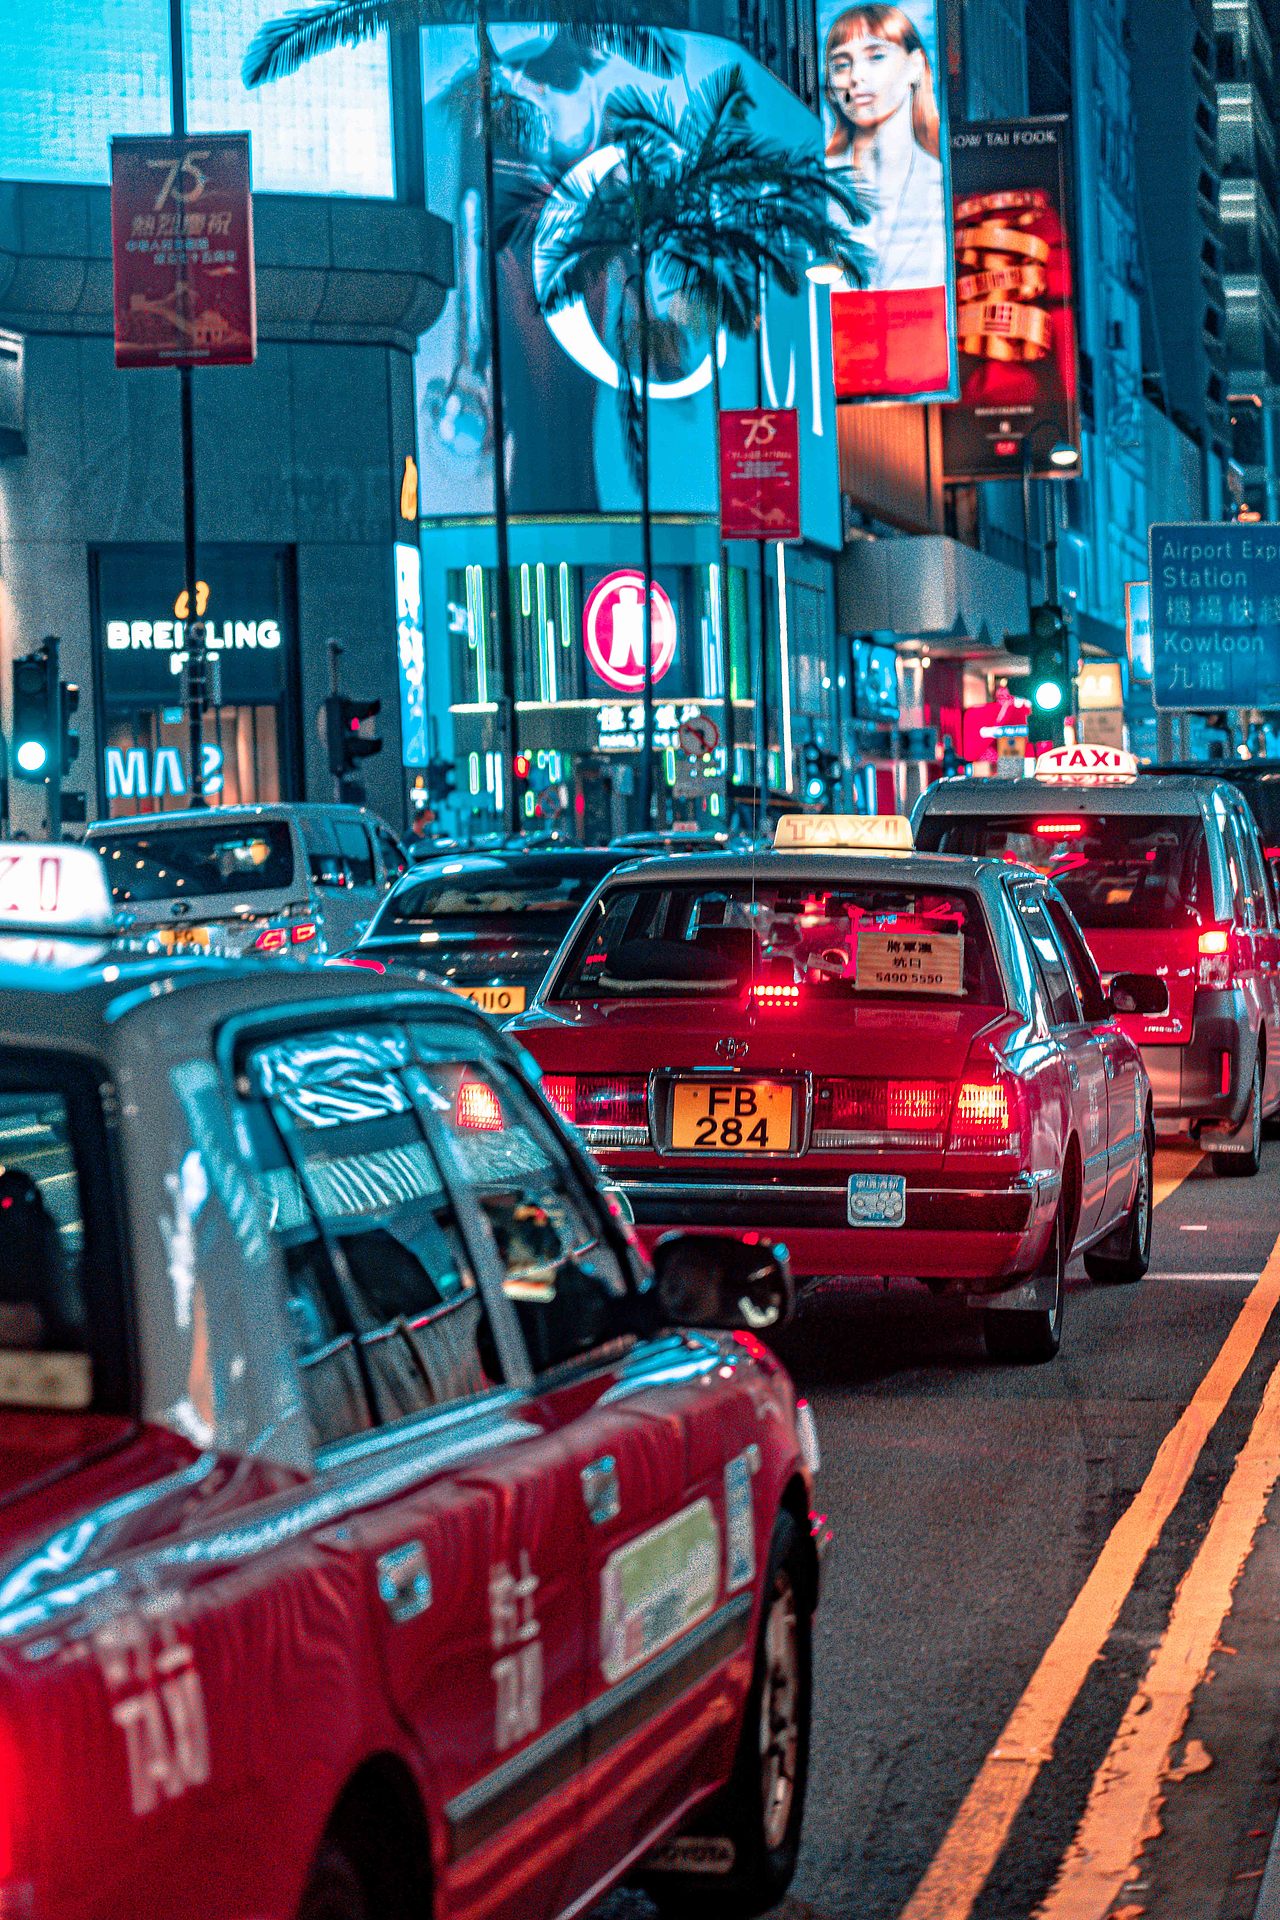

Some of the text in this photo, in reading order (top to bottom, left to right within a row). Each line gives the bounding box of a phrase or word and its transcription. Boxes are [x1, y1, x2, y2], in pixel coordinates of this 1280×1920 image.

[951, 133, 981, 148] OW
[1013, 129, 1057, 145] FOOK
[145, 150, 211, 211] 75
[740, 414, 777, 449] 75
[1162, 541, 1231, 561] Airport
[1163, 566, 1247, 588] Station
[107, 619, 281, 650] BREILING
[1164, 631, 1264, 653] Kowloon
[1169, 660, 1224, 691] 九龍
[1050, 749, 1121, 767] TAXI
[786, 817, 899, 842] TAXI
[708, 1086, 758, 1117] FB
[694, 1117, 769, 1147] 284
[1218, 1143, 1245, 1152] TOYOTA
